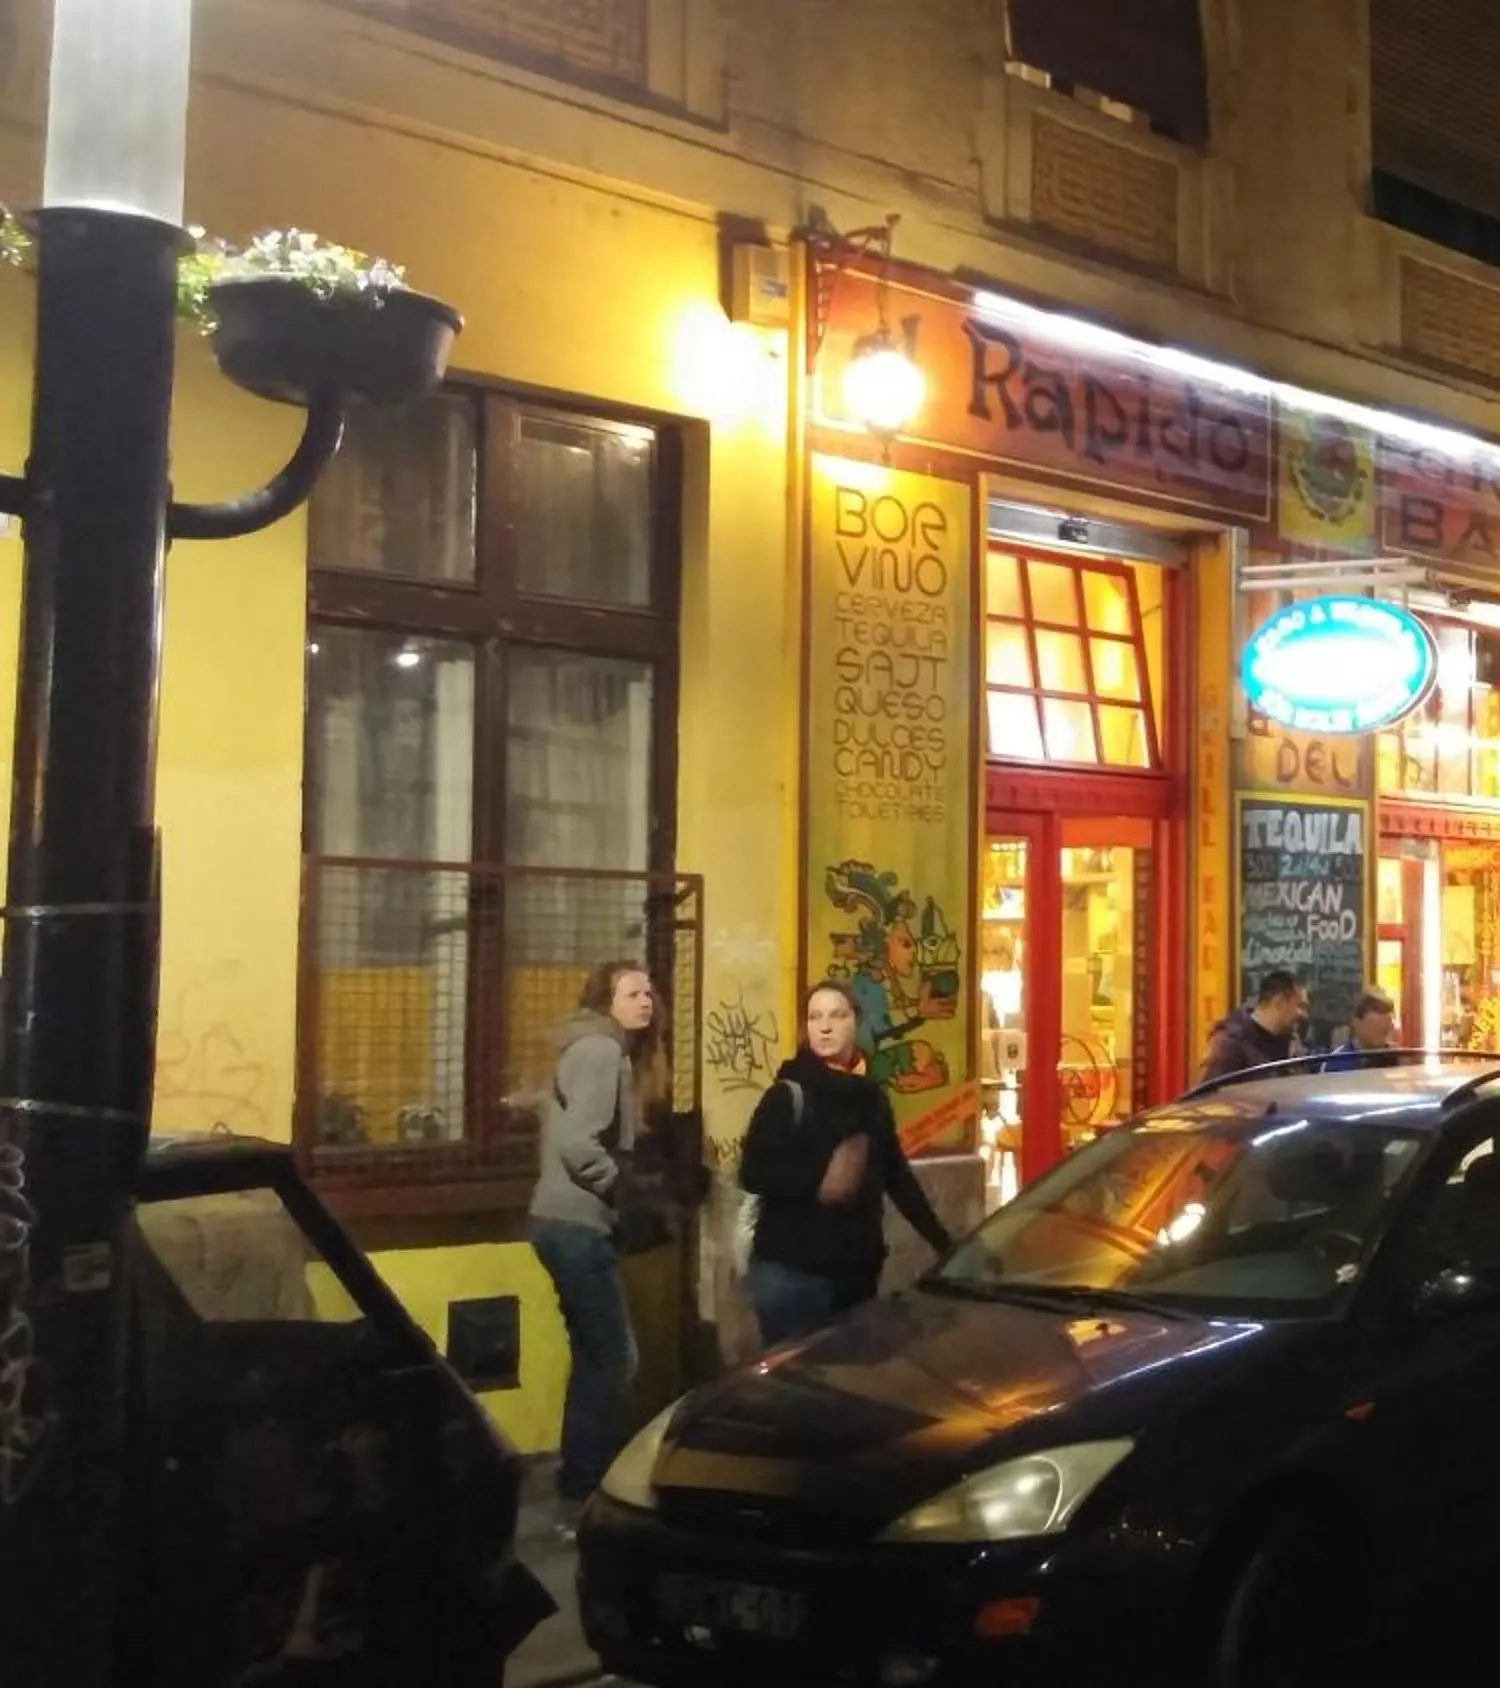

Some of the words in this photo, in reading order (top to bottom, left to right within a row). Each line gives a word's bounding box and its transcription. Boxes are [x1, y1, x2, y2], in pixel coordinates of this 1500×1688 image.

[962, 315, 1250, 474] Rapido
[836, 486, 947, 551] BOR
[836, 540, 947, 597] VINO
[835, 591, 946, 624] CERVEZA
[834, 616, 947, 653] TEQUILA
[836, 647, 947, 691] SAJT
[835, 685, 946, 722] QUESO
[833, 718, 946, 752] DULCES
[834, 747, 947, 783] CANDY
[1244, 809, 1364, 854] TEQUILA
[1246, 880, 1344, 914] MEXICAN
